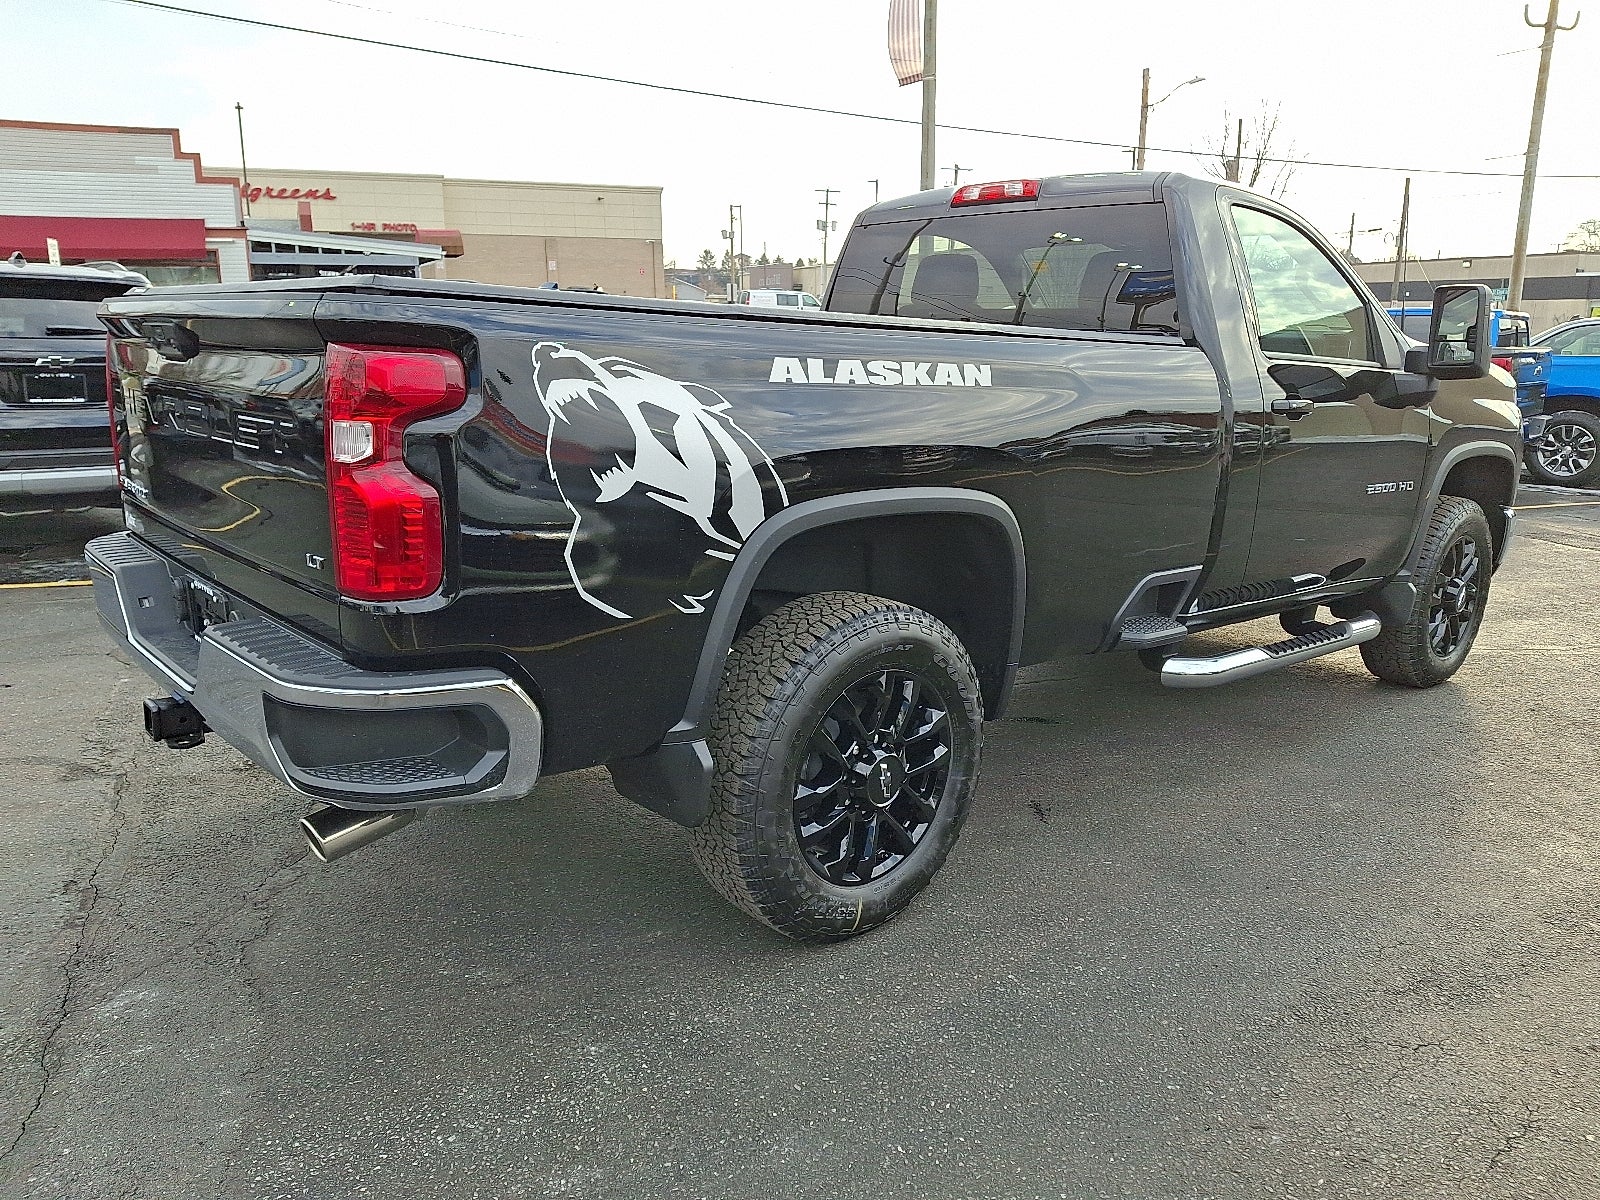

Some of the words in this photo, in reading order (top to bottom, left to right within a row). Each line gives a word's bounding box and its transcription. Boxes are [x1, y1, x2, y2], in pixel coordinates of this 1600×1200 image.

[350, 222, 376, 232] 1-HR
[381, 222, 417, 232] PHOTO
[768, 356, 993, 387] ALASKAN
[1366, 482, 1397, 495] 2500
[1399, 480, 1414, 492] HD
[305, 553, 326, 570] LT
